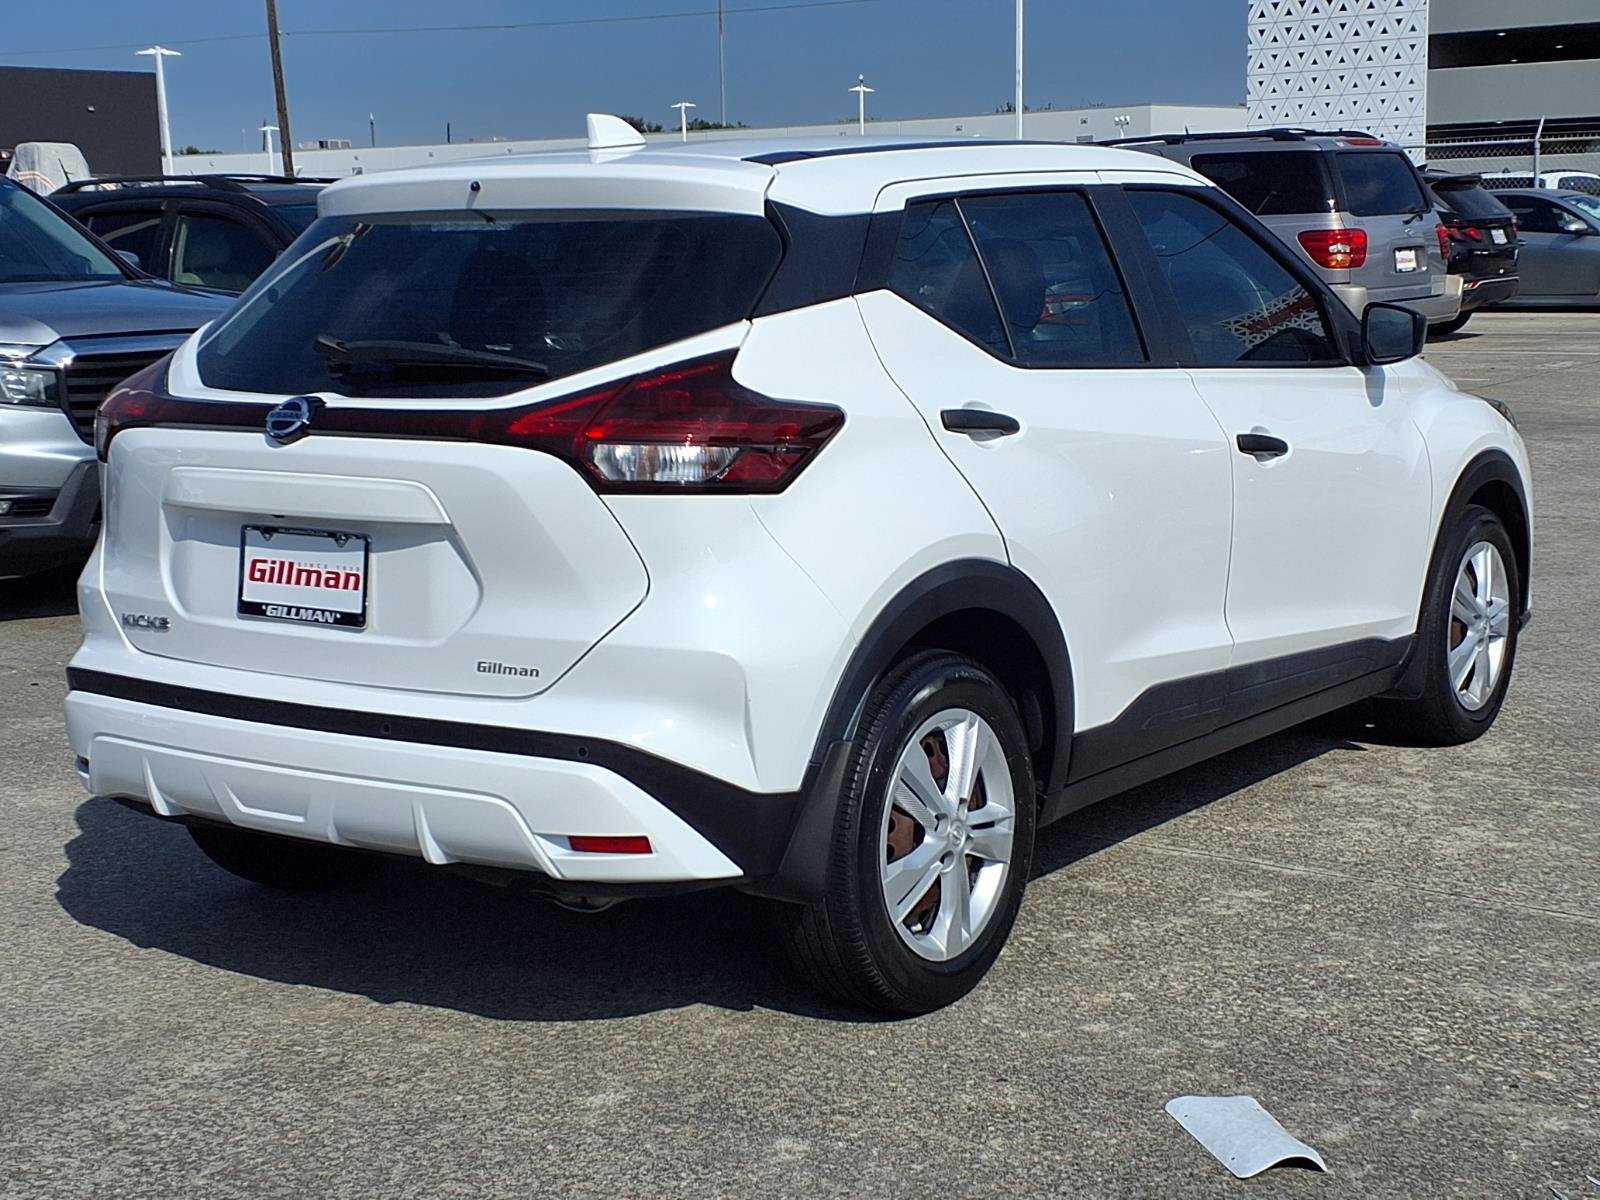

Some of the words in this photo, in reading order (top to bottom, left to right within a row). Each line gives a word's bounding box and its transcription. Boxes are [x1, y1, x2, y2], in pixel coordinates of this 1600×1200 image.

[248, 558, 361, 592] Gillman
[121, 612, 171, 631] KICKS
[265, 604, 335, 623] GILLMAN
[476, 660, 540, 678] Gillman
